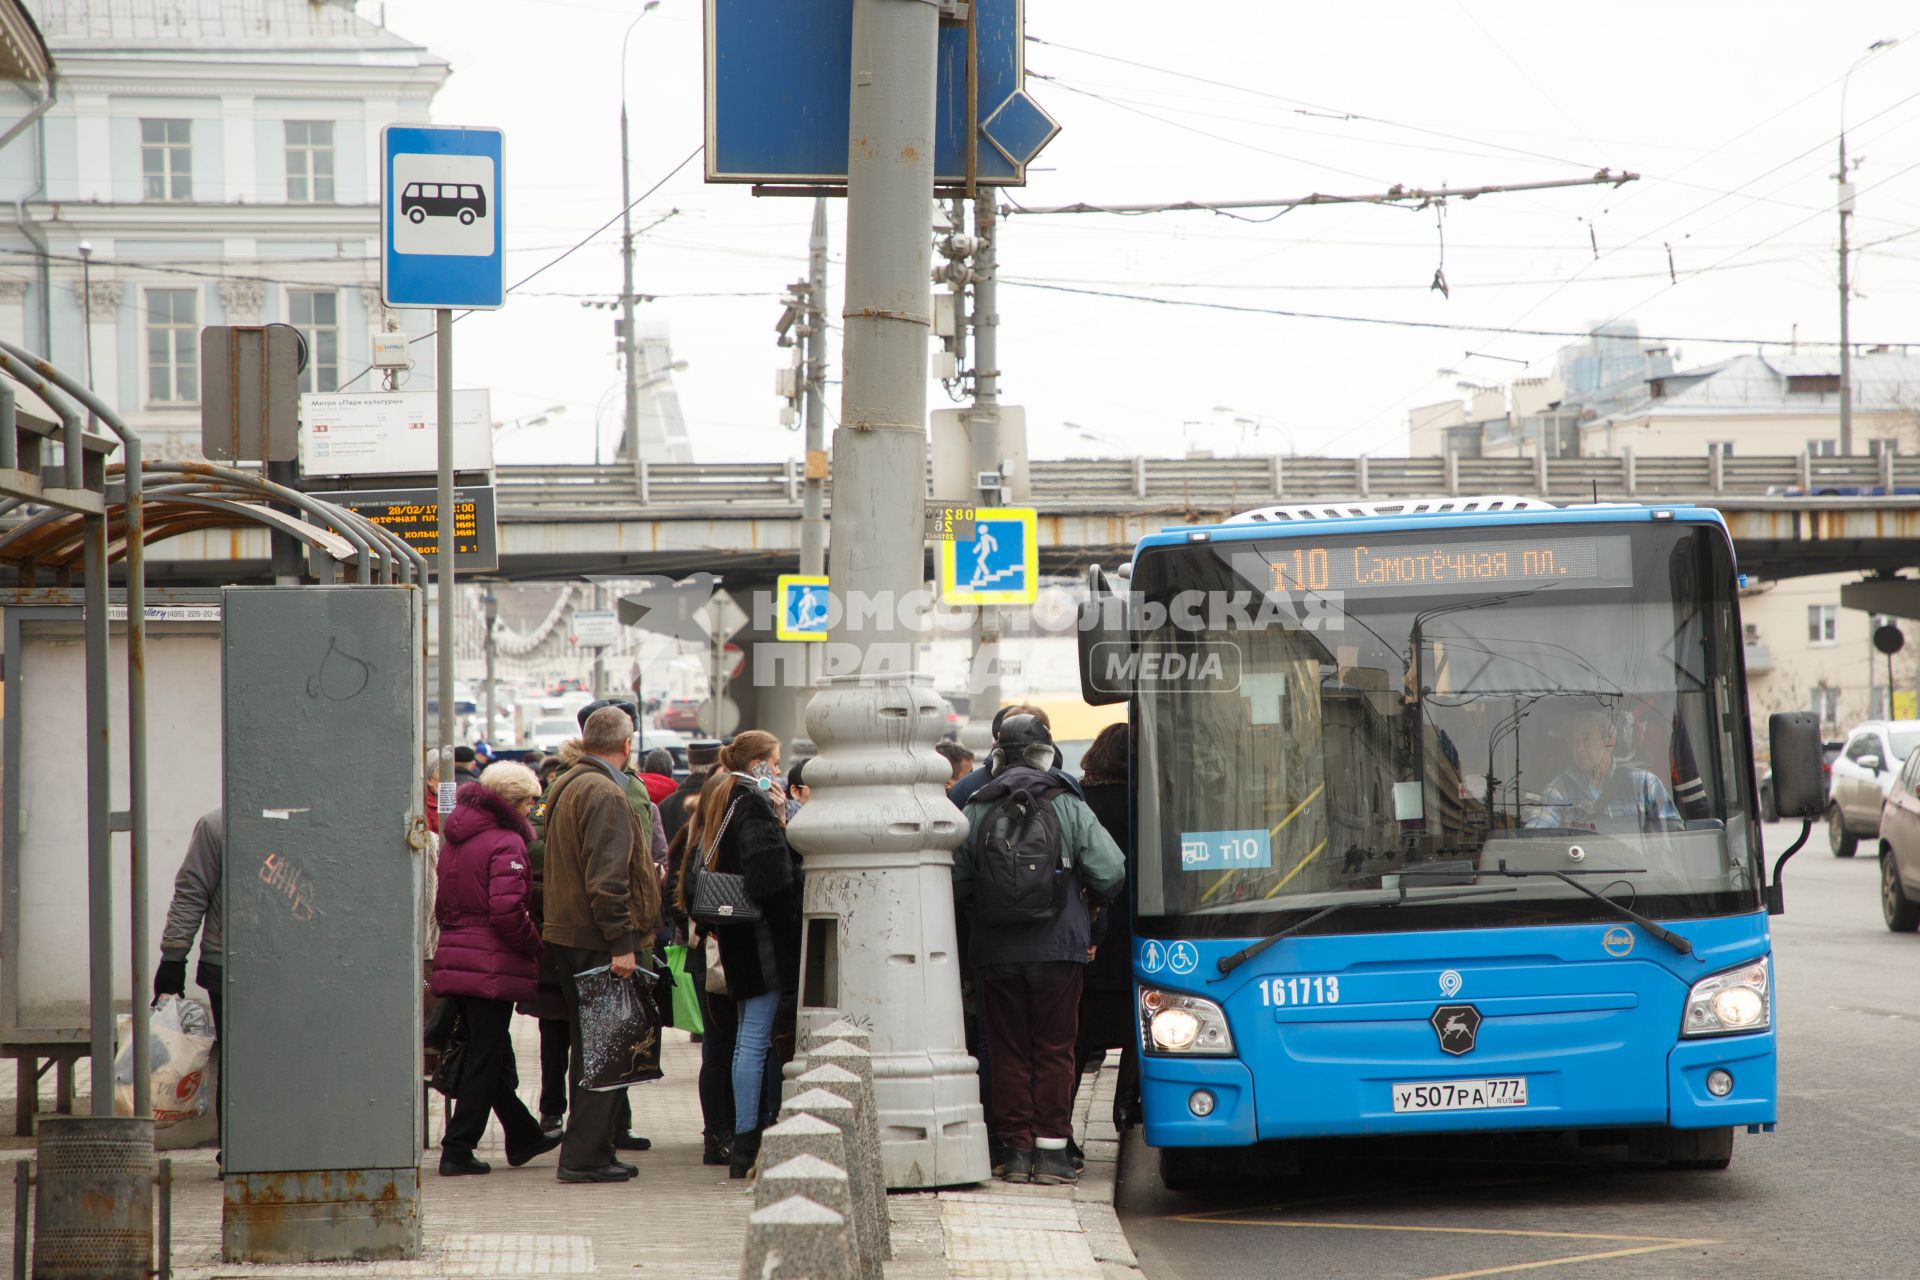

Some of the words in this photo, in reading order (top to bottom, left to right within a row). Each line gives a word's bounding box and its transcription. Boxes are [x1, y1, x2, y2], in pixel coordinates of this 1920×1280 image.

[1354, 546, 1509, 583] Самотёчная
[1523, 550, 1568, 577] пл.
[1219, 838, 1259, 861] т10
[1259, 976, 1340, 1006] 161713
[1488, 1080, 1520, 1098] 777
